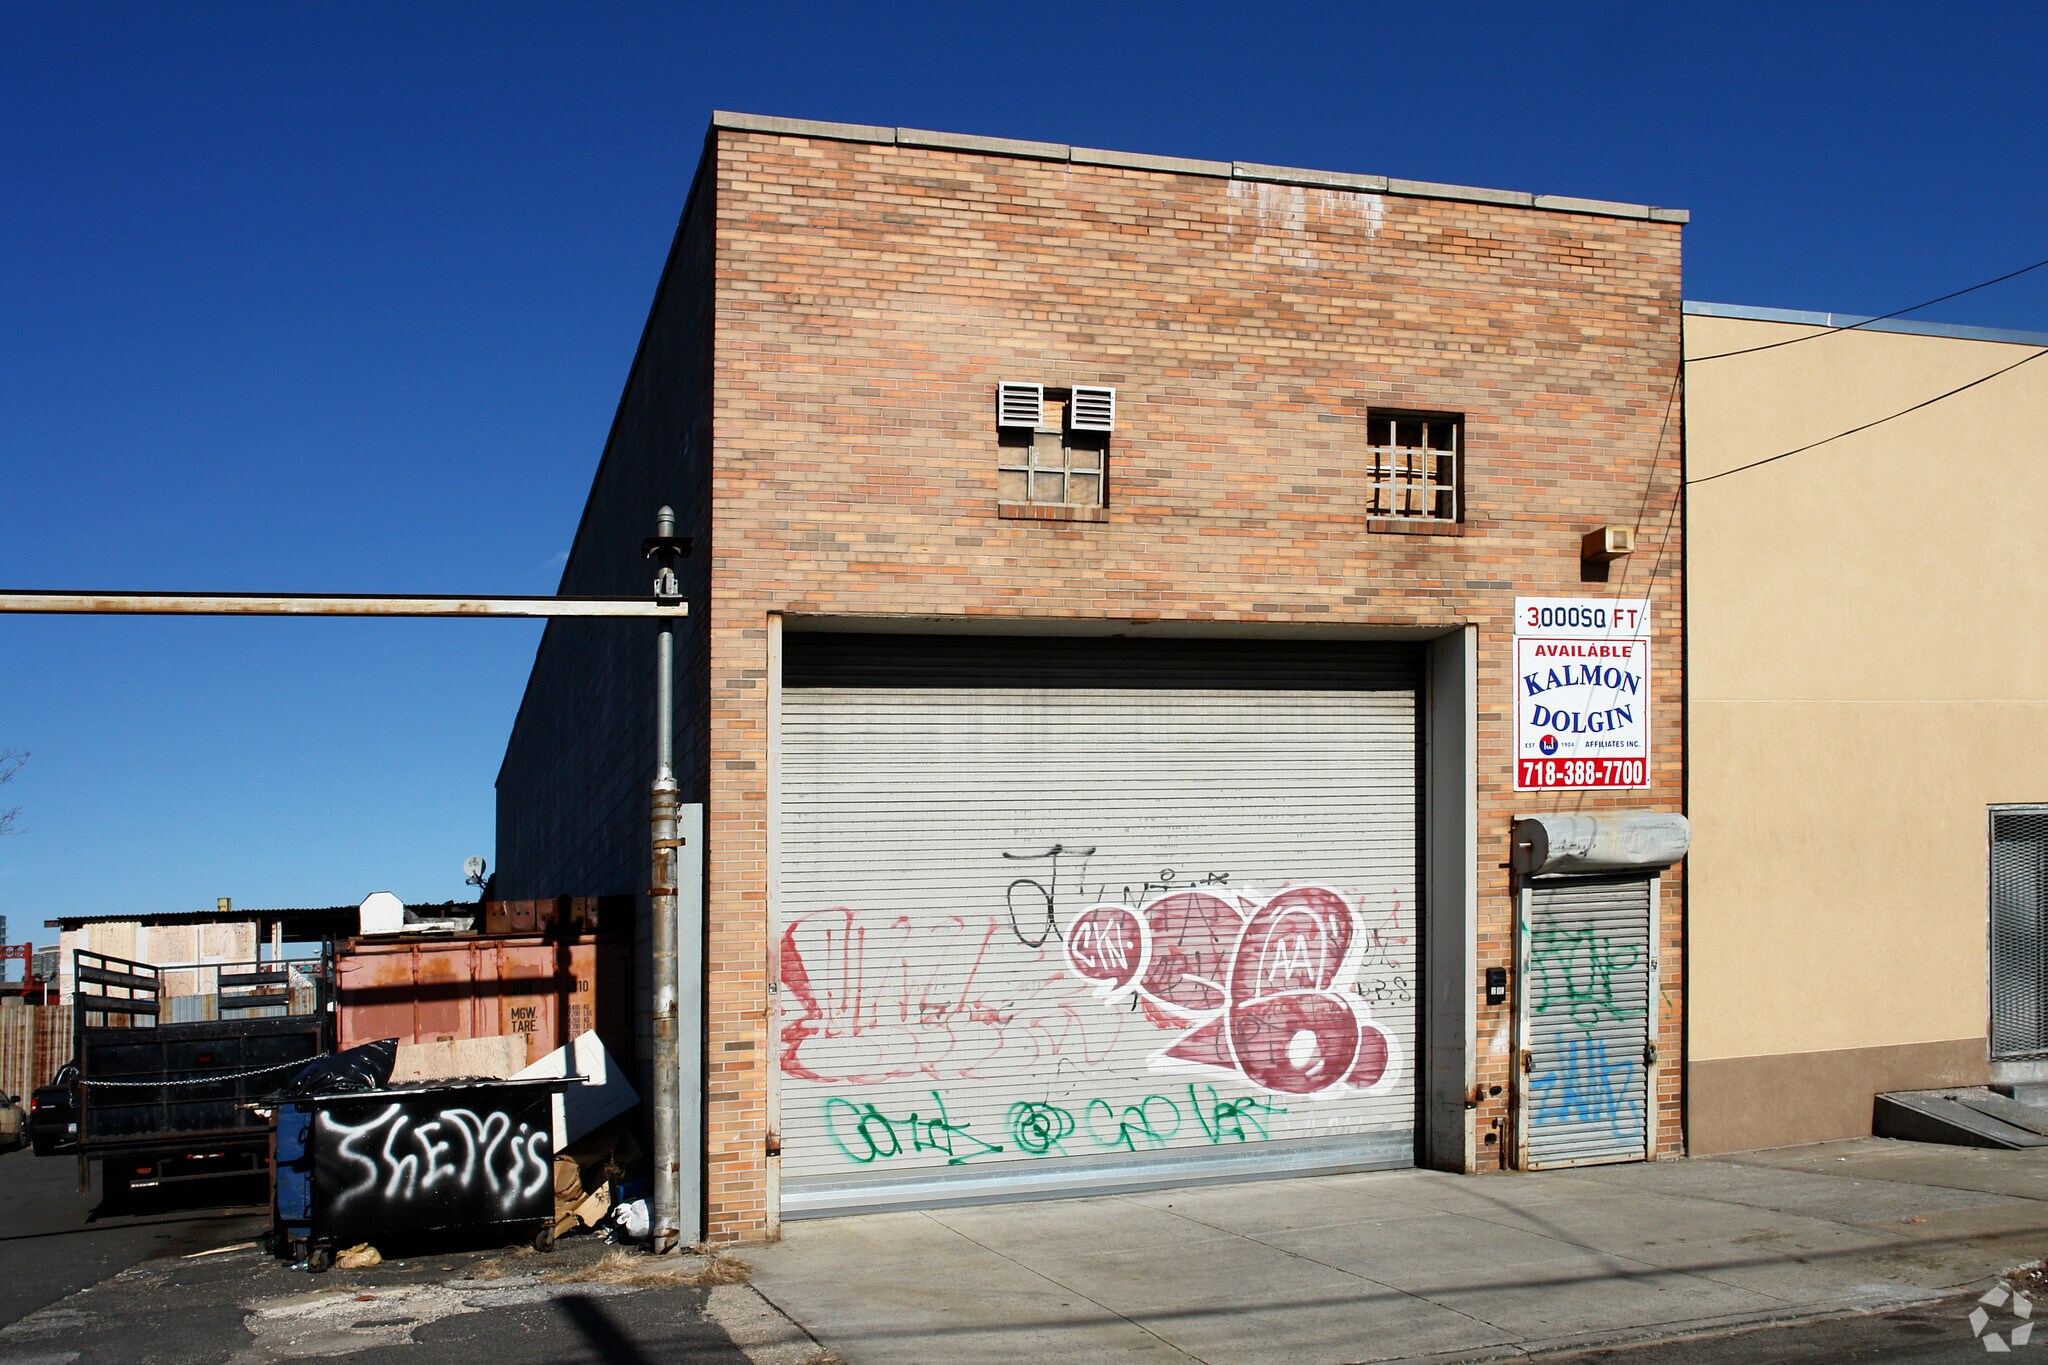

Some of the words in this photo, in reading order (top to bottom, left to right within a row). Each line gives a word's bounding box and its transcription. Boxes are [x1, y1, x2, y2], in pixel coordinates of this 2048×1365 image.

[1613, 608, 1638, 629] FT
[1534, 644, 1632, 658] AVAILABLE
[1523, 663, 1642, 697] KALMON
[1530, 703, 1634, 734] DOLGIN
[1584, 740, 1625, 748] AFFILIATES
[1626, 740, 1642, 748] INC.
[1522, 760, 1643, 786] 718-388-7700
[512, 982, 534, 996] USA
[511, 1006, 538, 1020] MGW.
[511, 1019, 539, 1033] TARE.
